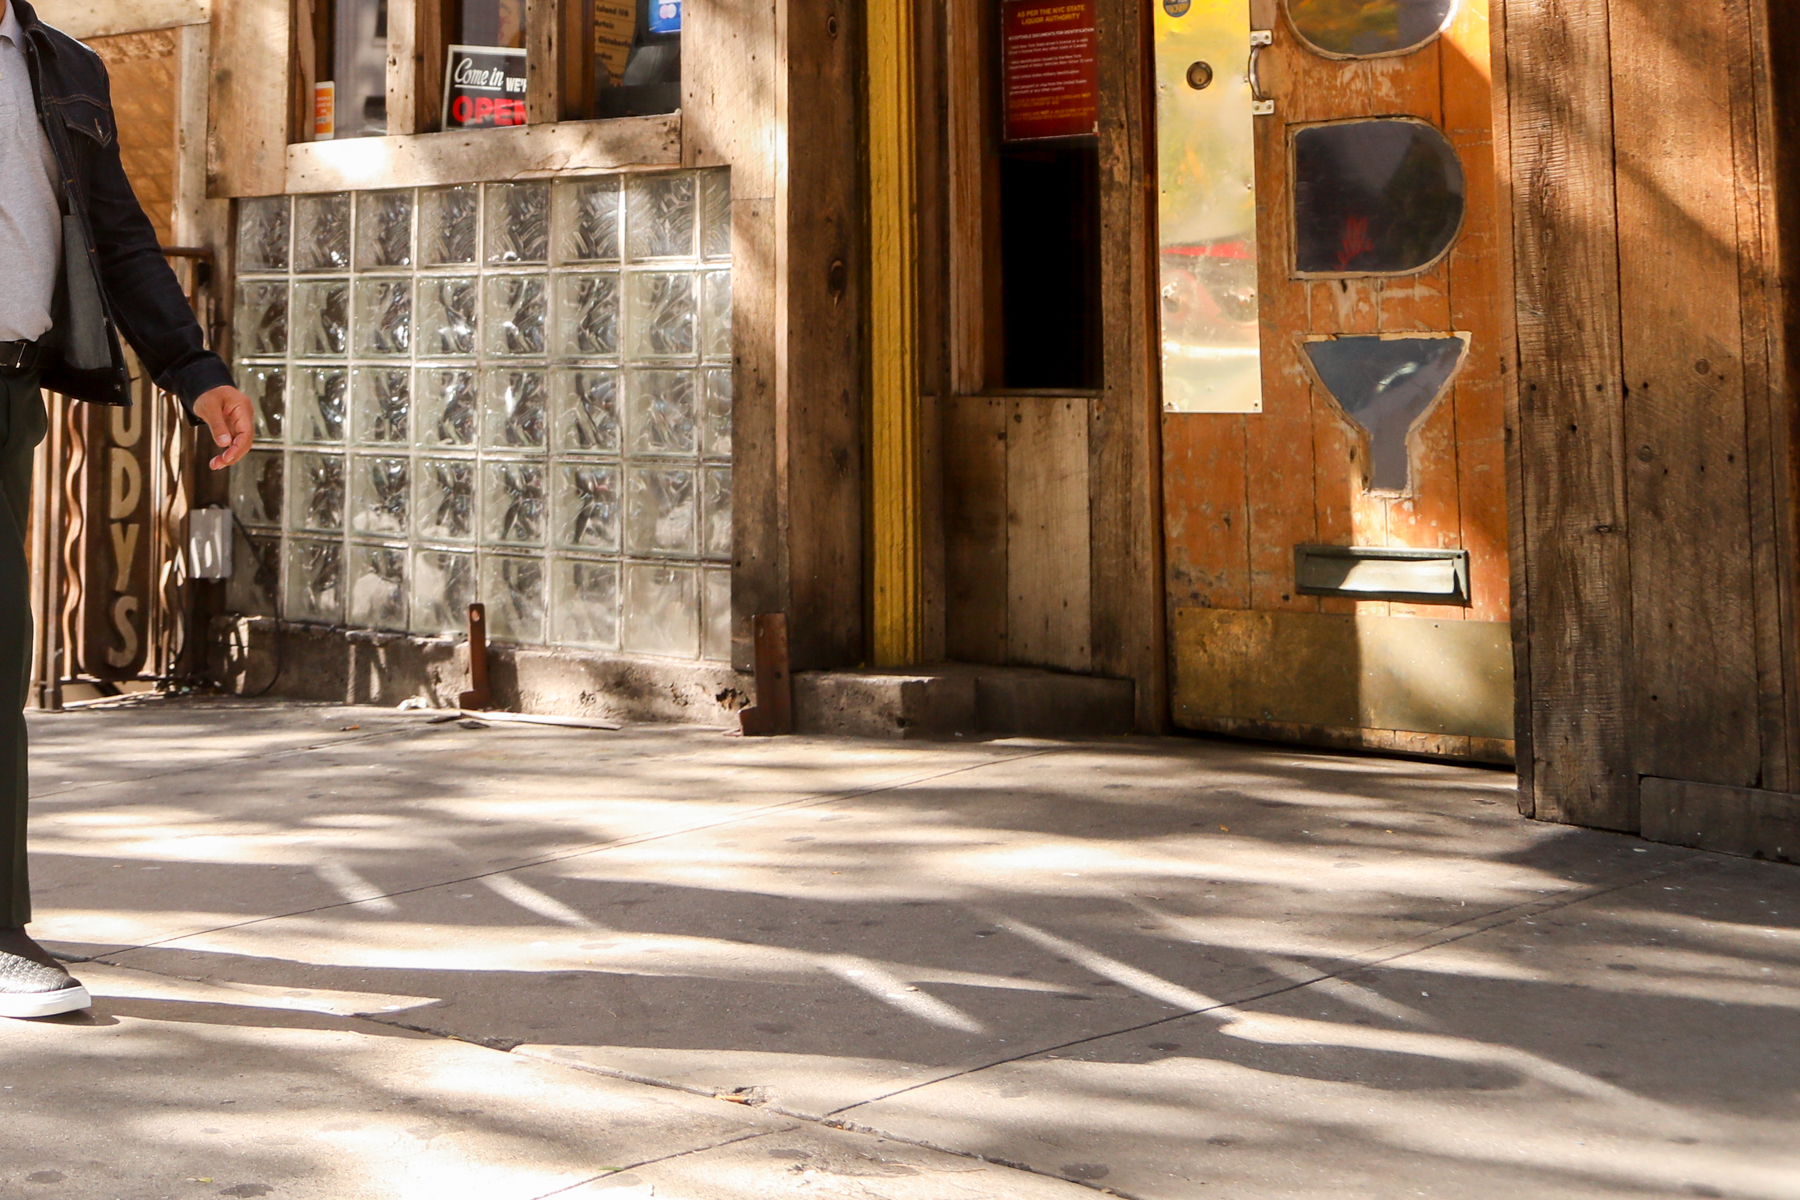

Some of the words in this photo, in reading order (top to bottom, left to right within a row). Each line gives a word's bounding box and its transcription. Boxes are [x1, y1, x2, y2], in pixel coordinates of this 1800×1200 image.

[1039, 7, 1052, 16] THE
[1052, 6, 1065, 14] NYC
[1066, 4, 1085, 12] STATE
[1021, 16, 1044, 26] LIQUOR
[1044, 12, 1081, 23] AUTHORITY
[454, 57, 490, 86] Come
[489, 66, 505, 87] in
